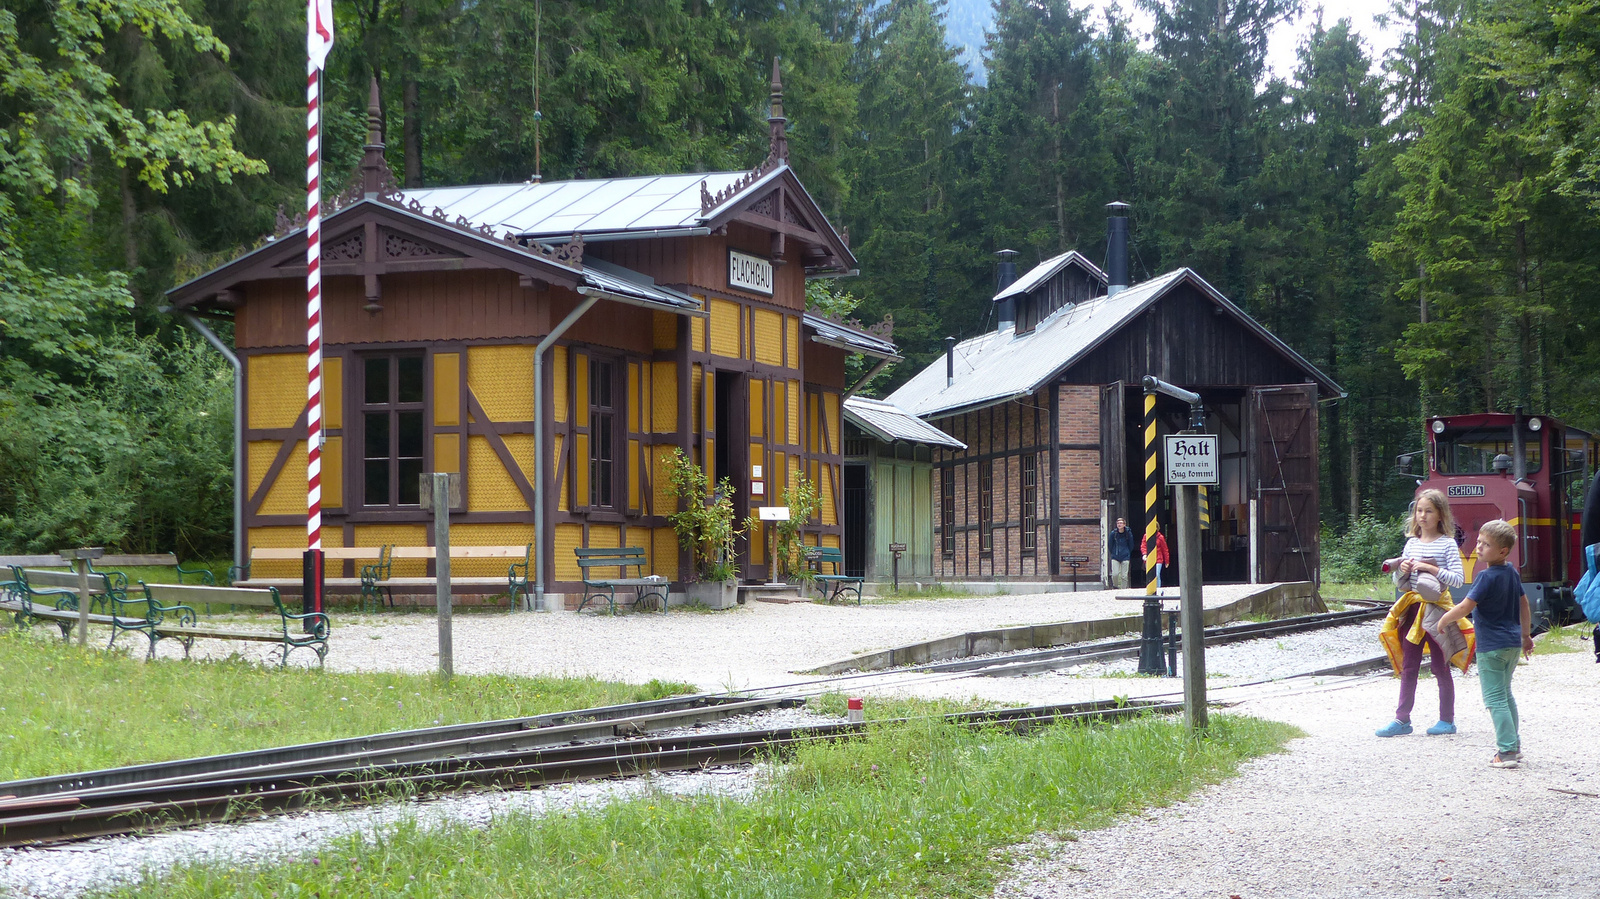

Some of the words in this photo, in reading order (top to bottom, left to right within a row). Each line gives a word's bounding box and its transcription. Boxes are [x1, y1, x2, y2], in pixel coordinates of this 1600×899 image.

[732, 256, 770, 288] FLACHGAU
[1174, 440, 1210, 460] Halt
[1197, 460, 1209, 468] ein
[1171, 470, 1187, 479] Zug
[1188, 470, 1214, 478] kommt
[1449, 485, 1483, 495] SCHÖMA
